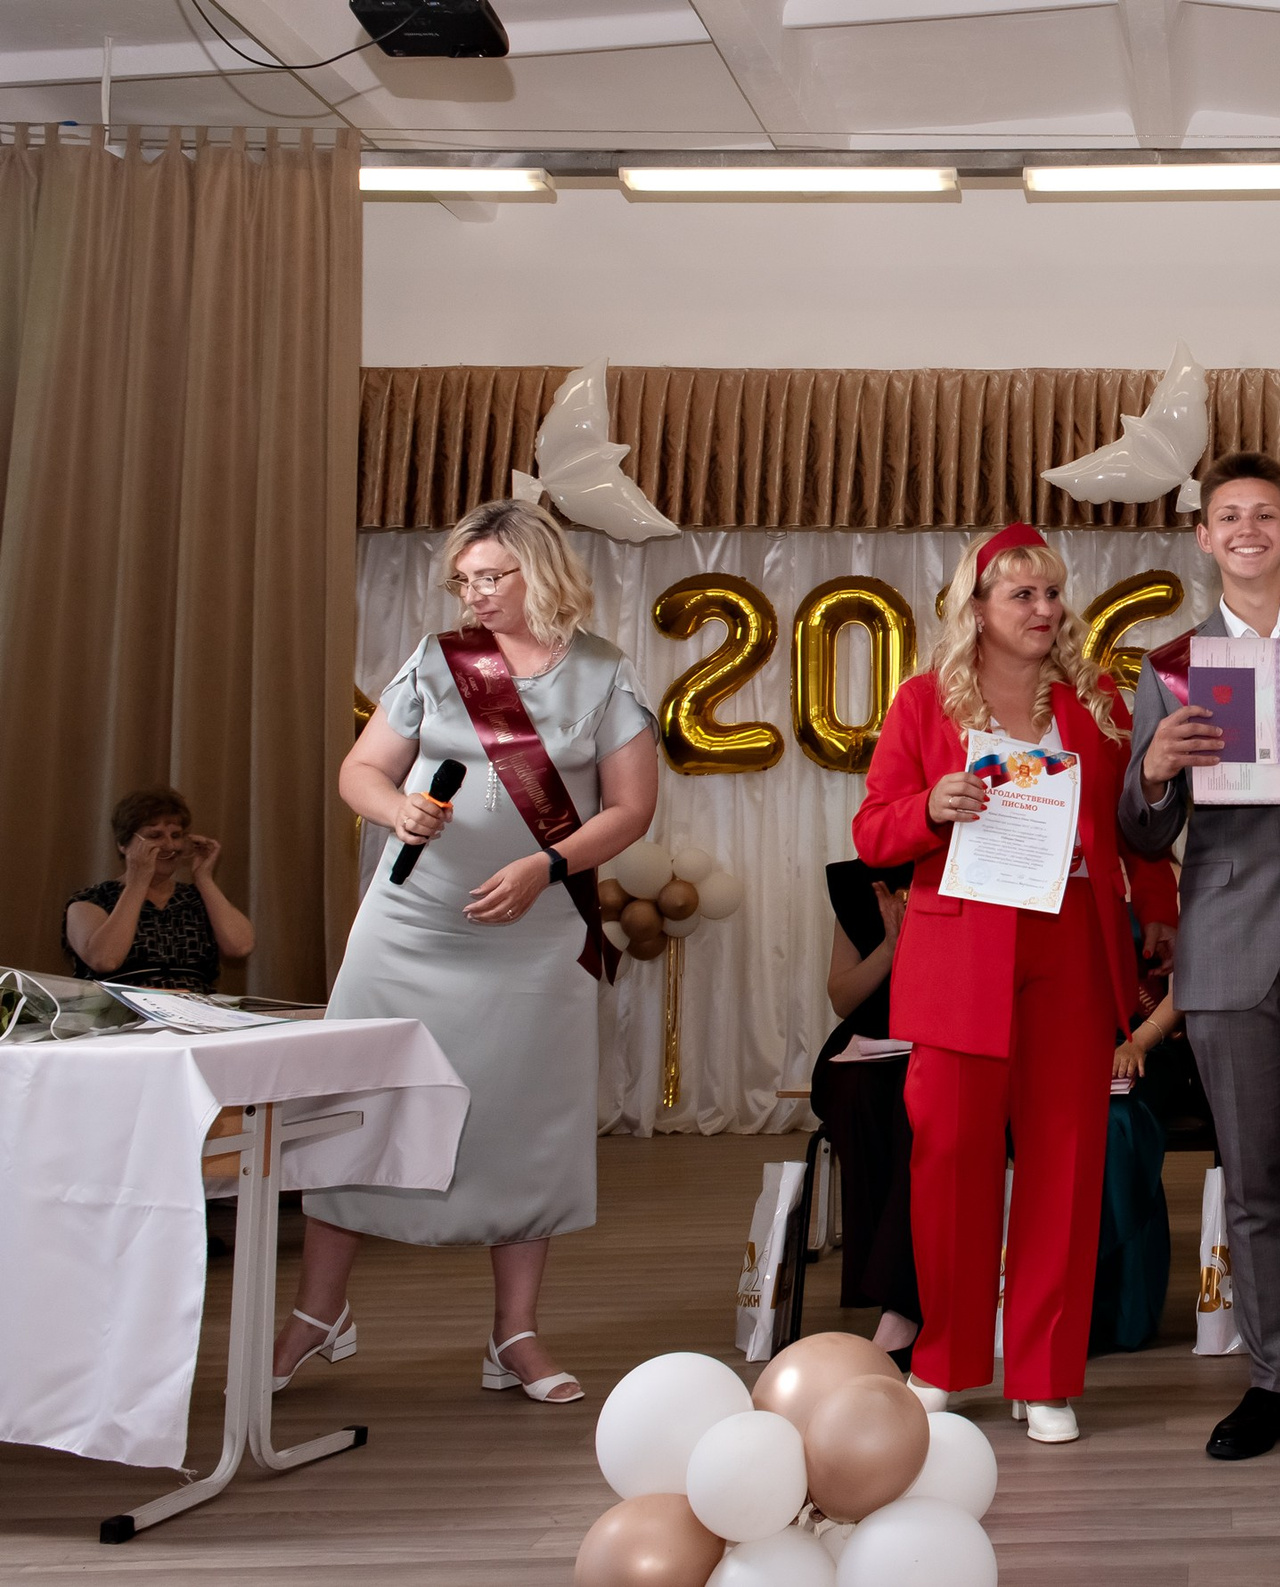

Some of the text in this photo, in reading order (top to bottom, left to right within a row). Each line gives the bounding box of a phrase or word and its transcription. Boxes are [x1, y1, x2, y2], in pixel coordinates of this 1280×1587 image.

[652, 569, 1184, 776] 206
[984, 788, 1066, 807] АГОДАРСТВЕННОЕ
[1001, 799, 1038, 811] ПИСЬМО
